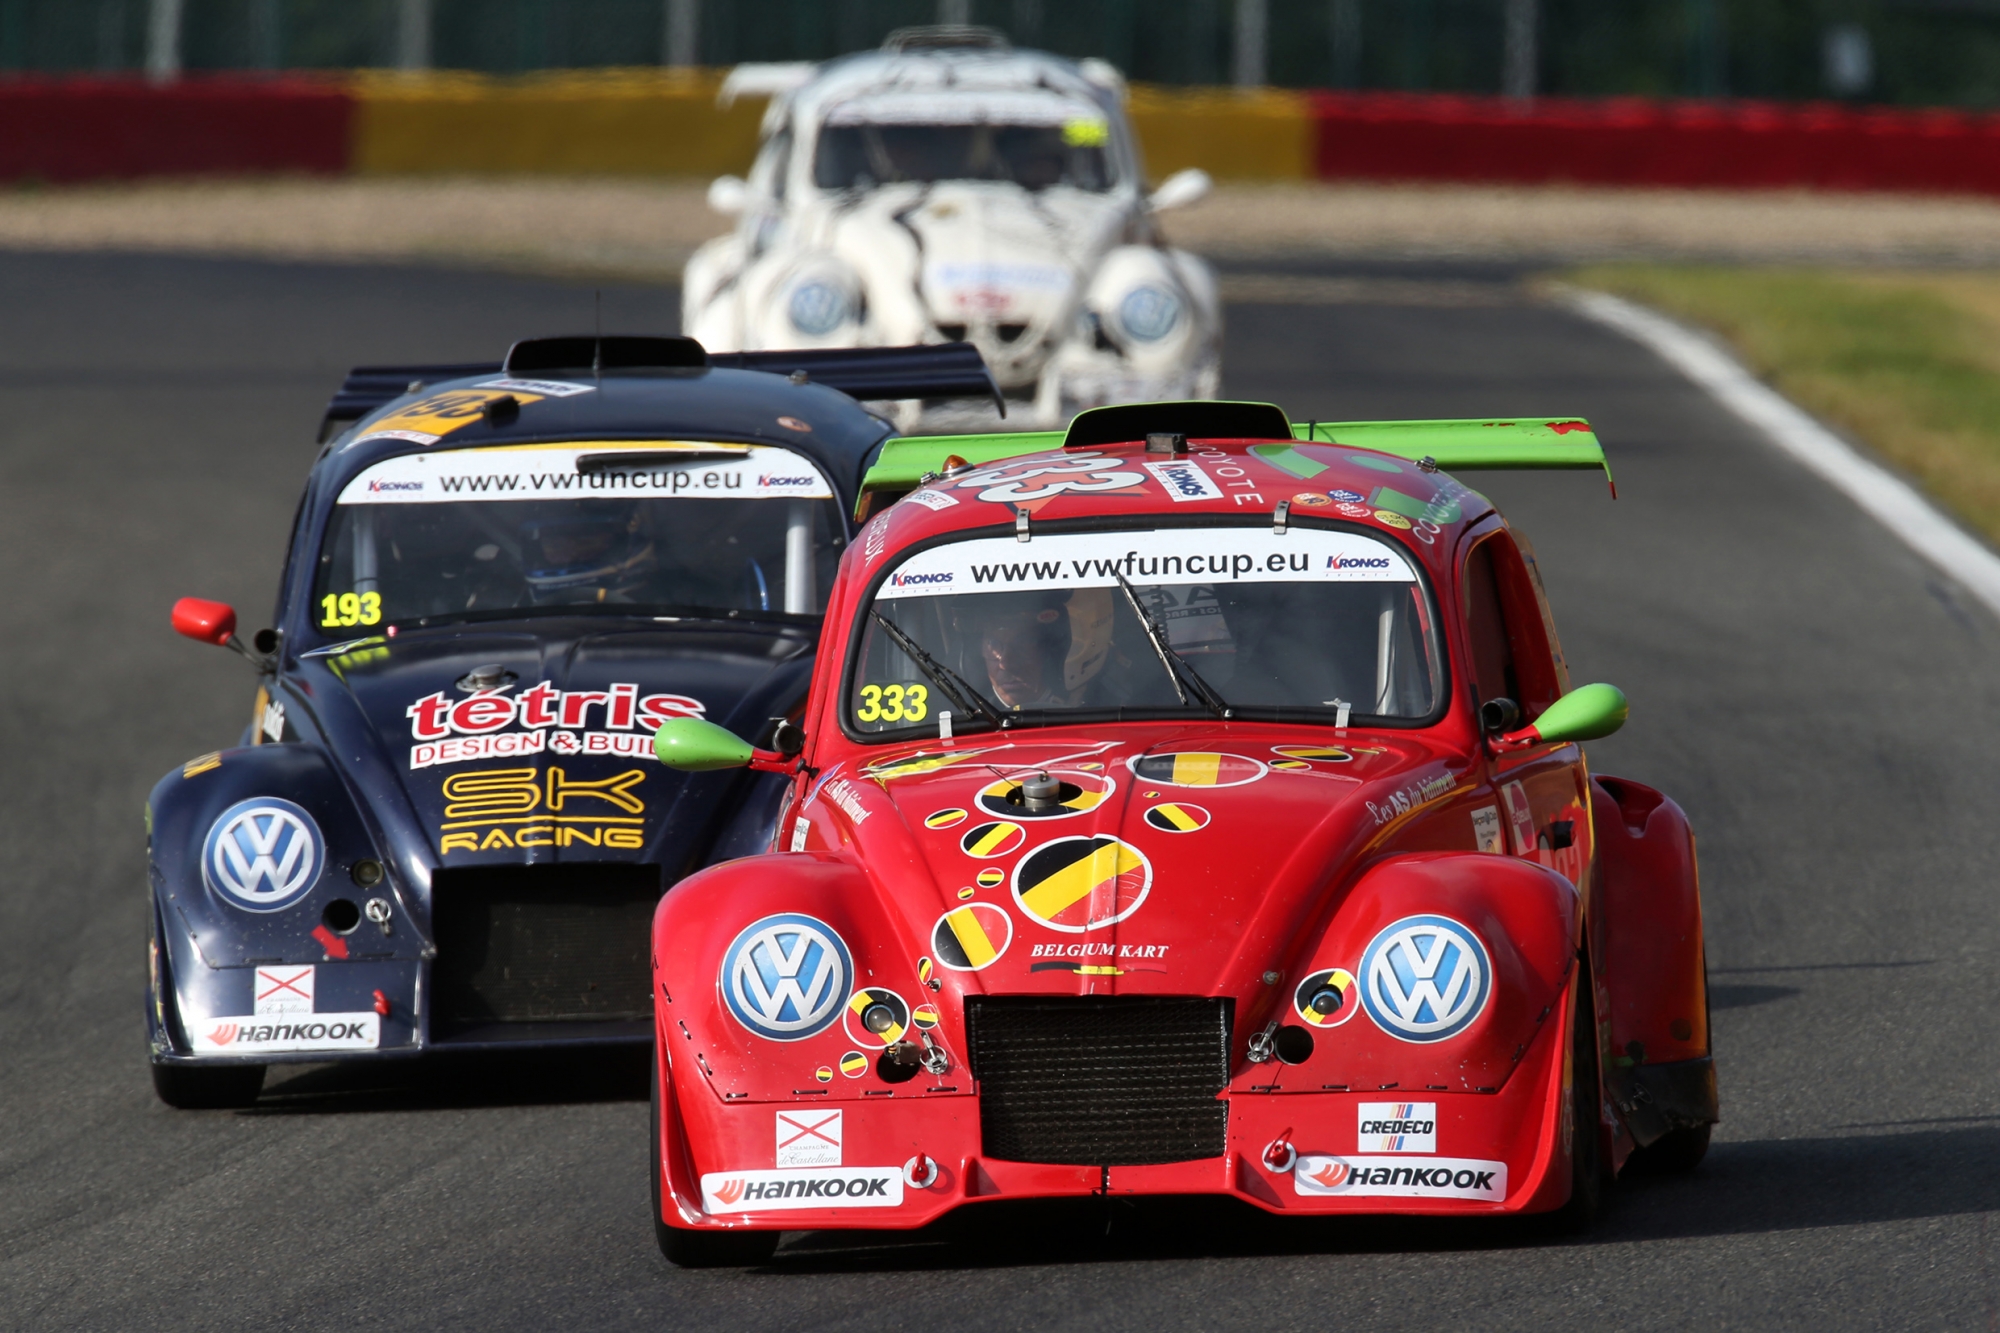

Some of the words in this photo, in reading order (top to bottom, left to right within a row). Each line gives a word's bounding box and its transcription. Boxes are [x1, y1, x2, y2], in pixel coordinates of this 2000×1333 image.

[438, 470, 742, 494] www.vwfuncup.eu
[757, 472, 815, 487] KRONOS
[1189, 446, 1265, 506] COYOTE
[970, 551, 1310, 583] www.vwfuncup.eu
[1326, 552, 1390, 570] KRONOS
[891, 569, 954, 587] KRONOS
[321, 591, 381, 627] 193
[406, 681, 706, 739] tétris
[857, 684, 928, 722] 333
[410, 729, 546, 769] DESIGN
[549, 731, 583, 754] &
[442, 766, 645, 818] SK
[1389, 791, 1410, 815] AS
[441, 827, 643, 855] RACING
[1030, 943, 1116, 957] BELGIUM
[1118, 945, 1169, 958] KART
[1360, 1120, 1434, 1135] CREDECO
